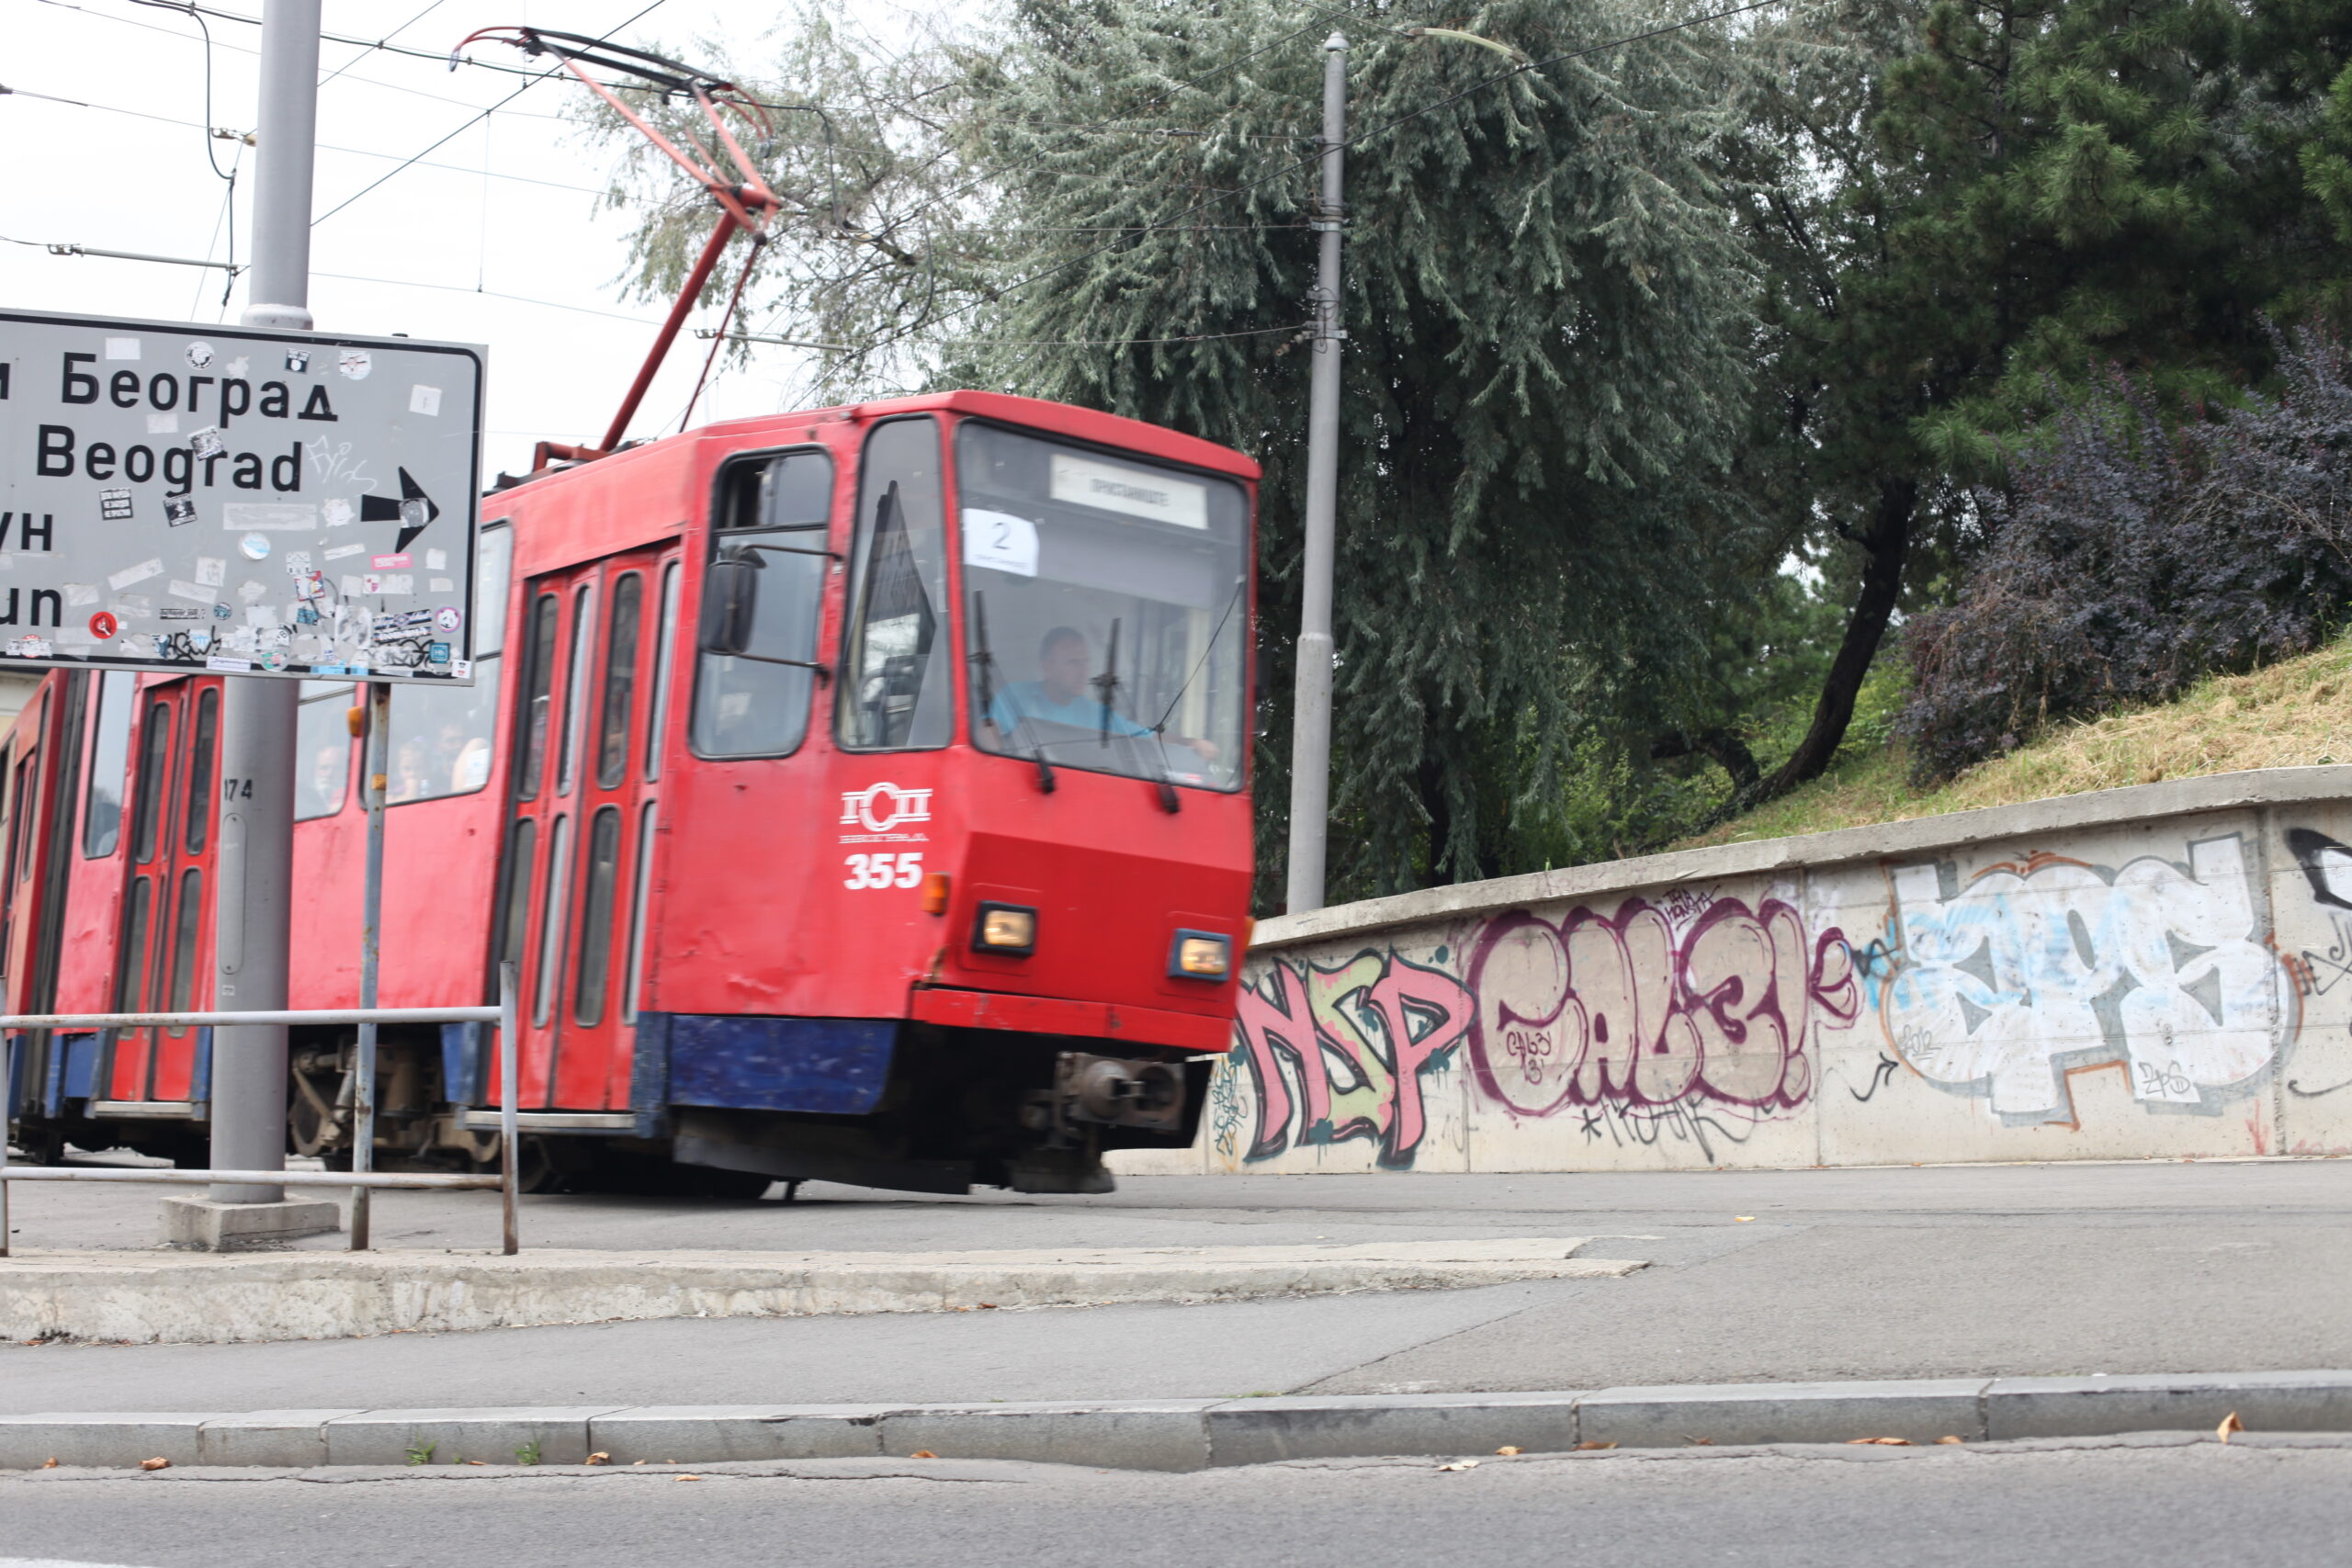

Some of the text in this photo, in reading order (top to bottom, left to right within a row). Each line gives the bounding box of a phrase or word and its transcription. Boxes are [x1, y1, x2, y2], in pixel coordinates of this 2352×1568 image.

[62, 352, 339, 429] Београд
[37, 423, 302, 497] Beograd
[992, 521, 1012, 550] 2
[224, 778, 253, 802] 174
[843, 852, 923, 890] 355
